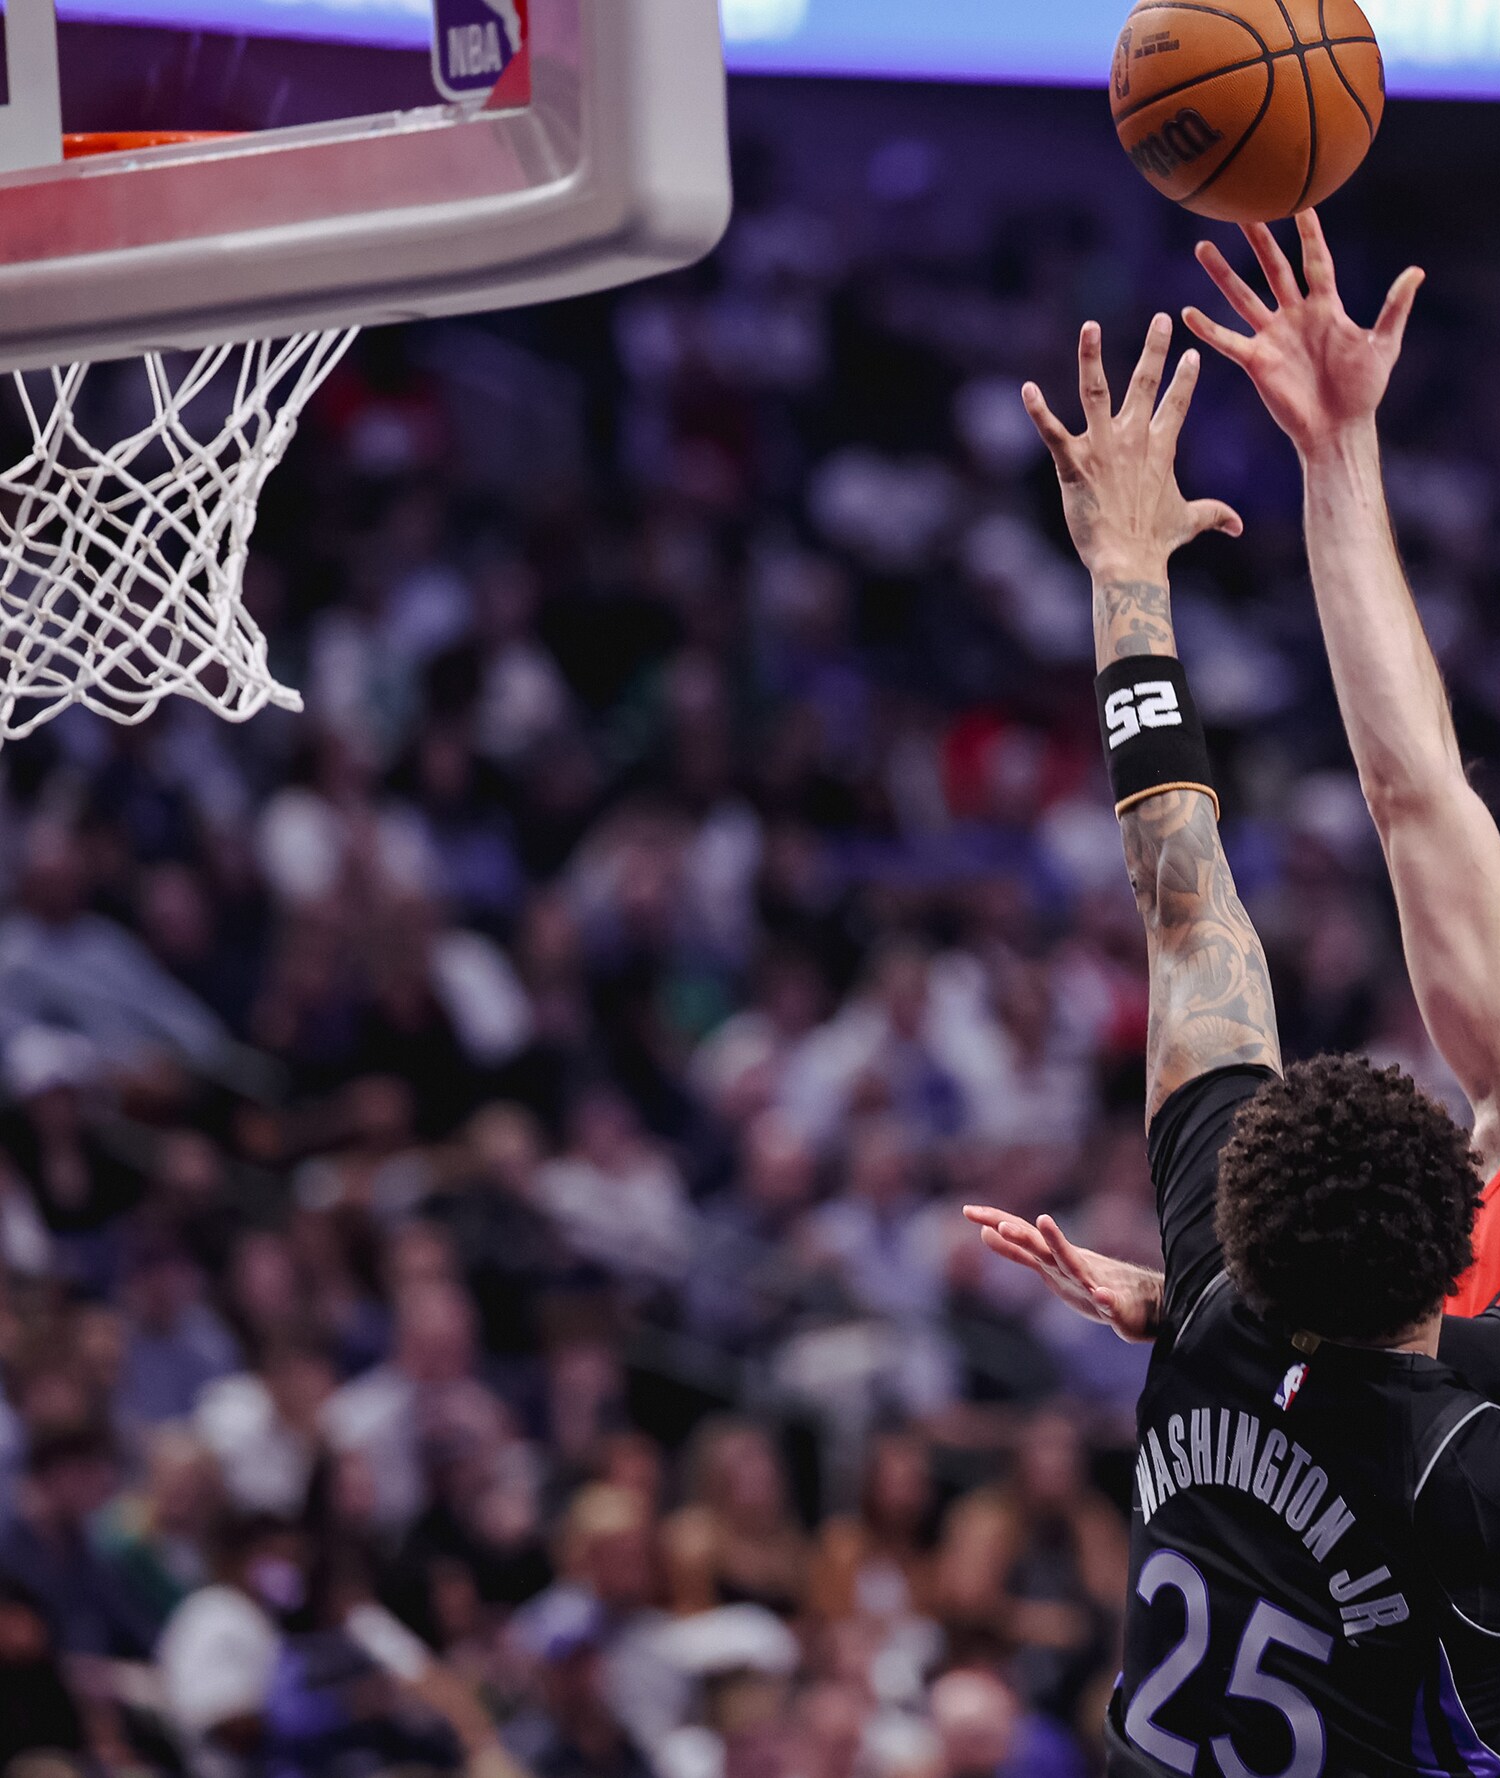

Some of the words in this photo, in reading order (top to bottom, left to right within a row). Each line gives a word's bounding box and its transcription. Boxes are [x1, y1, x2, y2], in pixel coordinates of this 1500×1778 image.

[447, 21, 503, 78] NBA
[1137, 1408, 1356, 1562] WASHINGTON
[1126, 1549, 1334, 1778] 25
